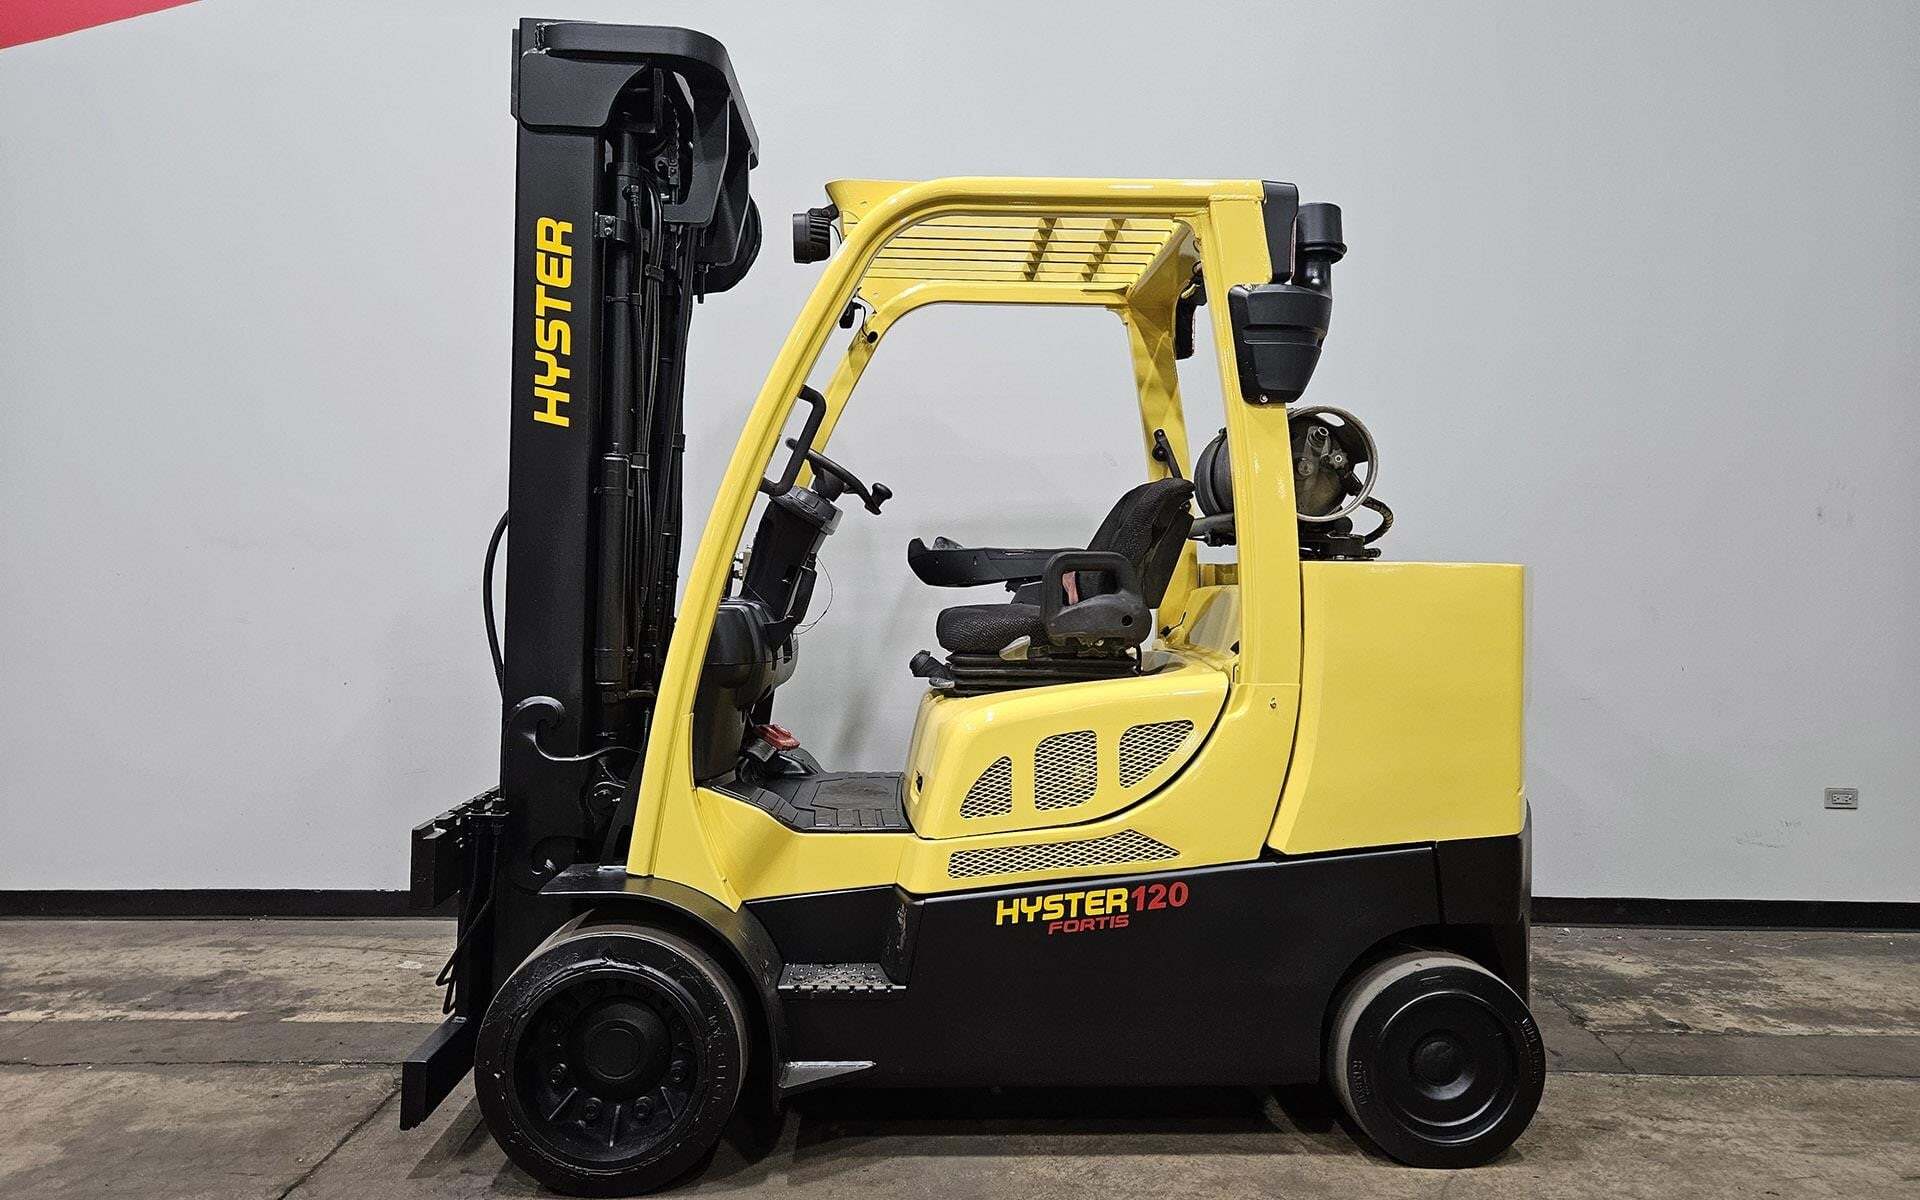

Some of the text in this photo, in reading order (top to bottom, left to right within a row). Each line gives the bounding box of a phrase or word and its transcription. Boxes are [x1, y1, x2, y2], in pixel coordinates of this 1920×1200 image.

[533, 216, 573, 428] HYSTER
[995, 881, 1189, 926] HYSTER 120
[1048, 914, 1130, 935] FORTIS
